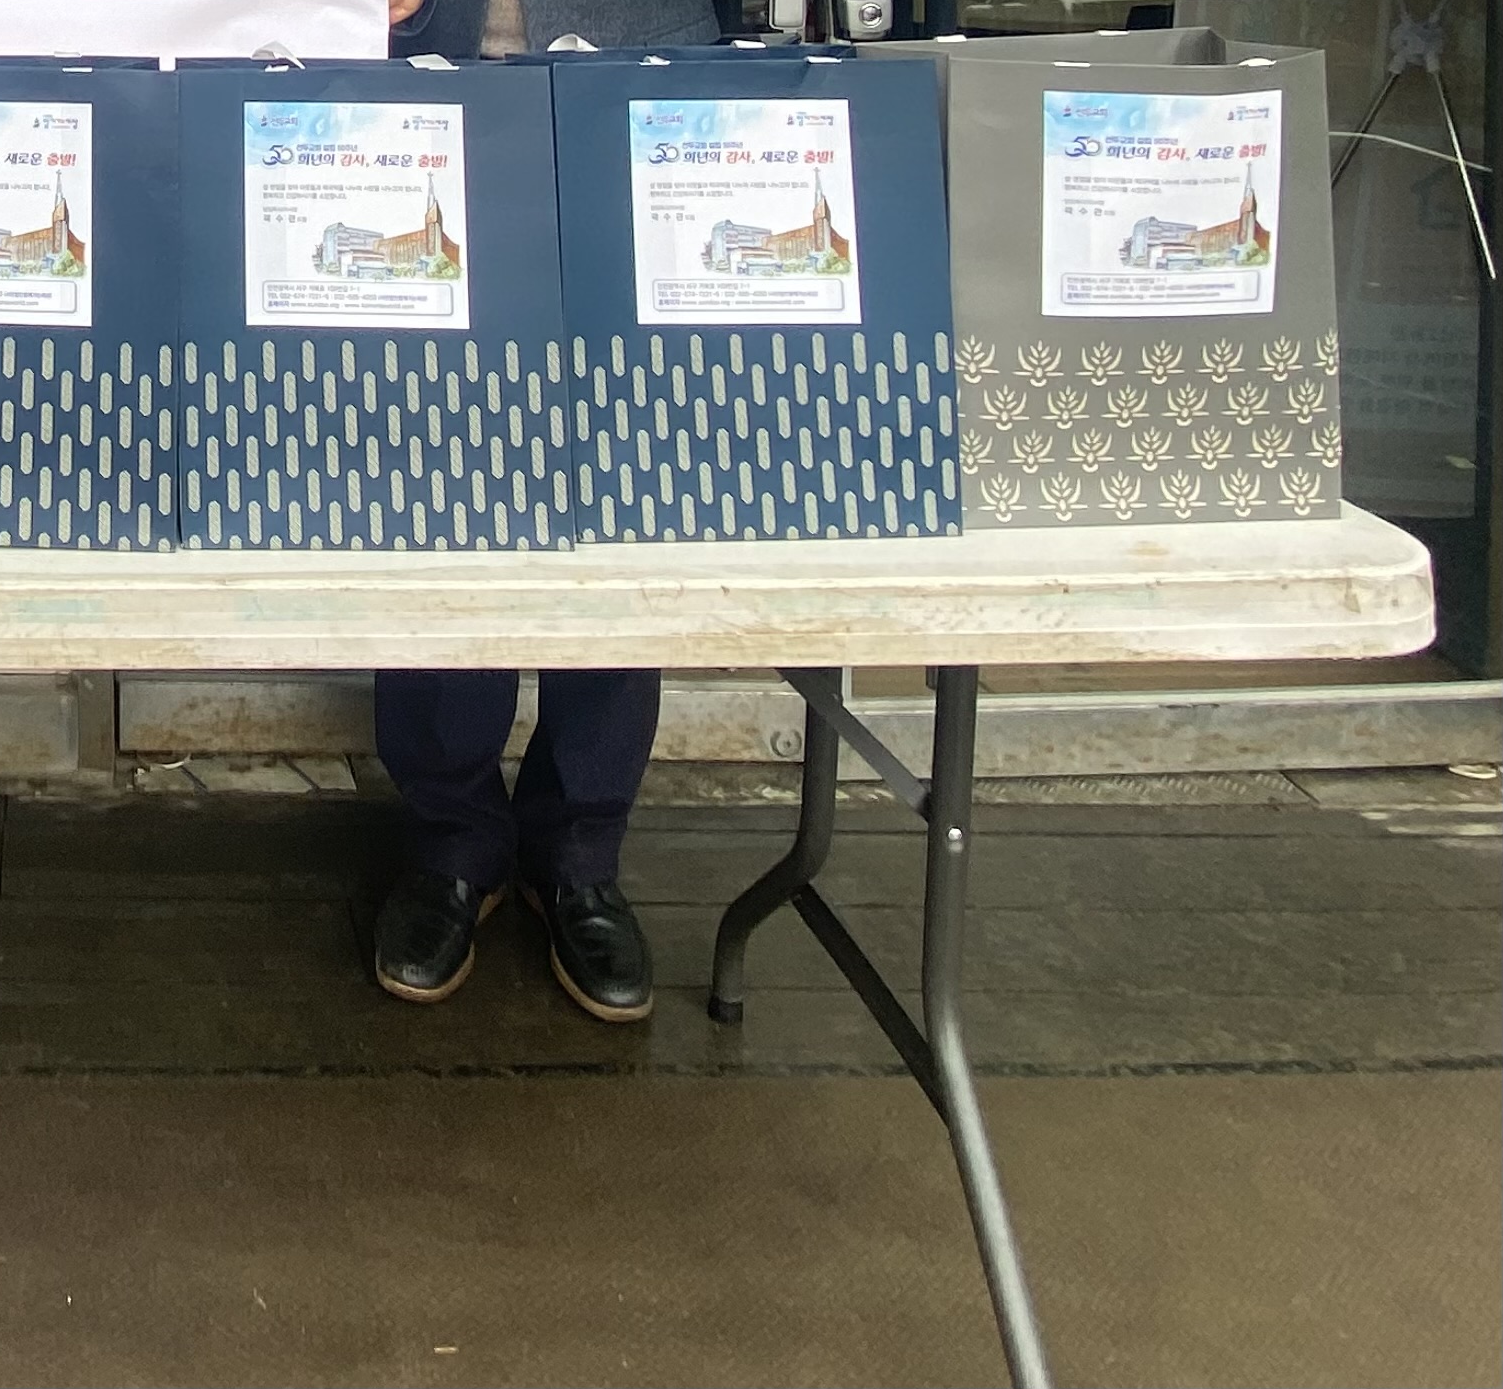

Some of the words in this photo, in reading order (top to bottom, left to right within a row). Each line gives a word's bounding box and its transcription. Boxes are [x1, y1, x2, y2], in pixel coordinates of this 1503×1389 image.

[759, 151, 798, 164] 새로운
[1195, 146, 1234, 159] 새로운
[4, 153, 42, 166] 새로운
[374, 154, 413, 167] 새로운
